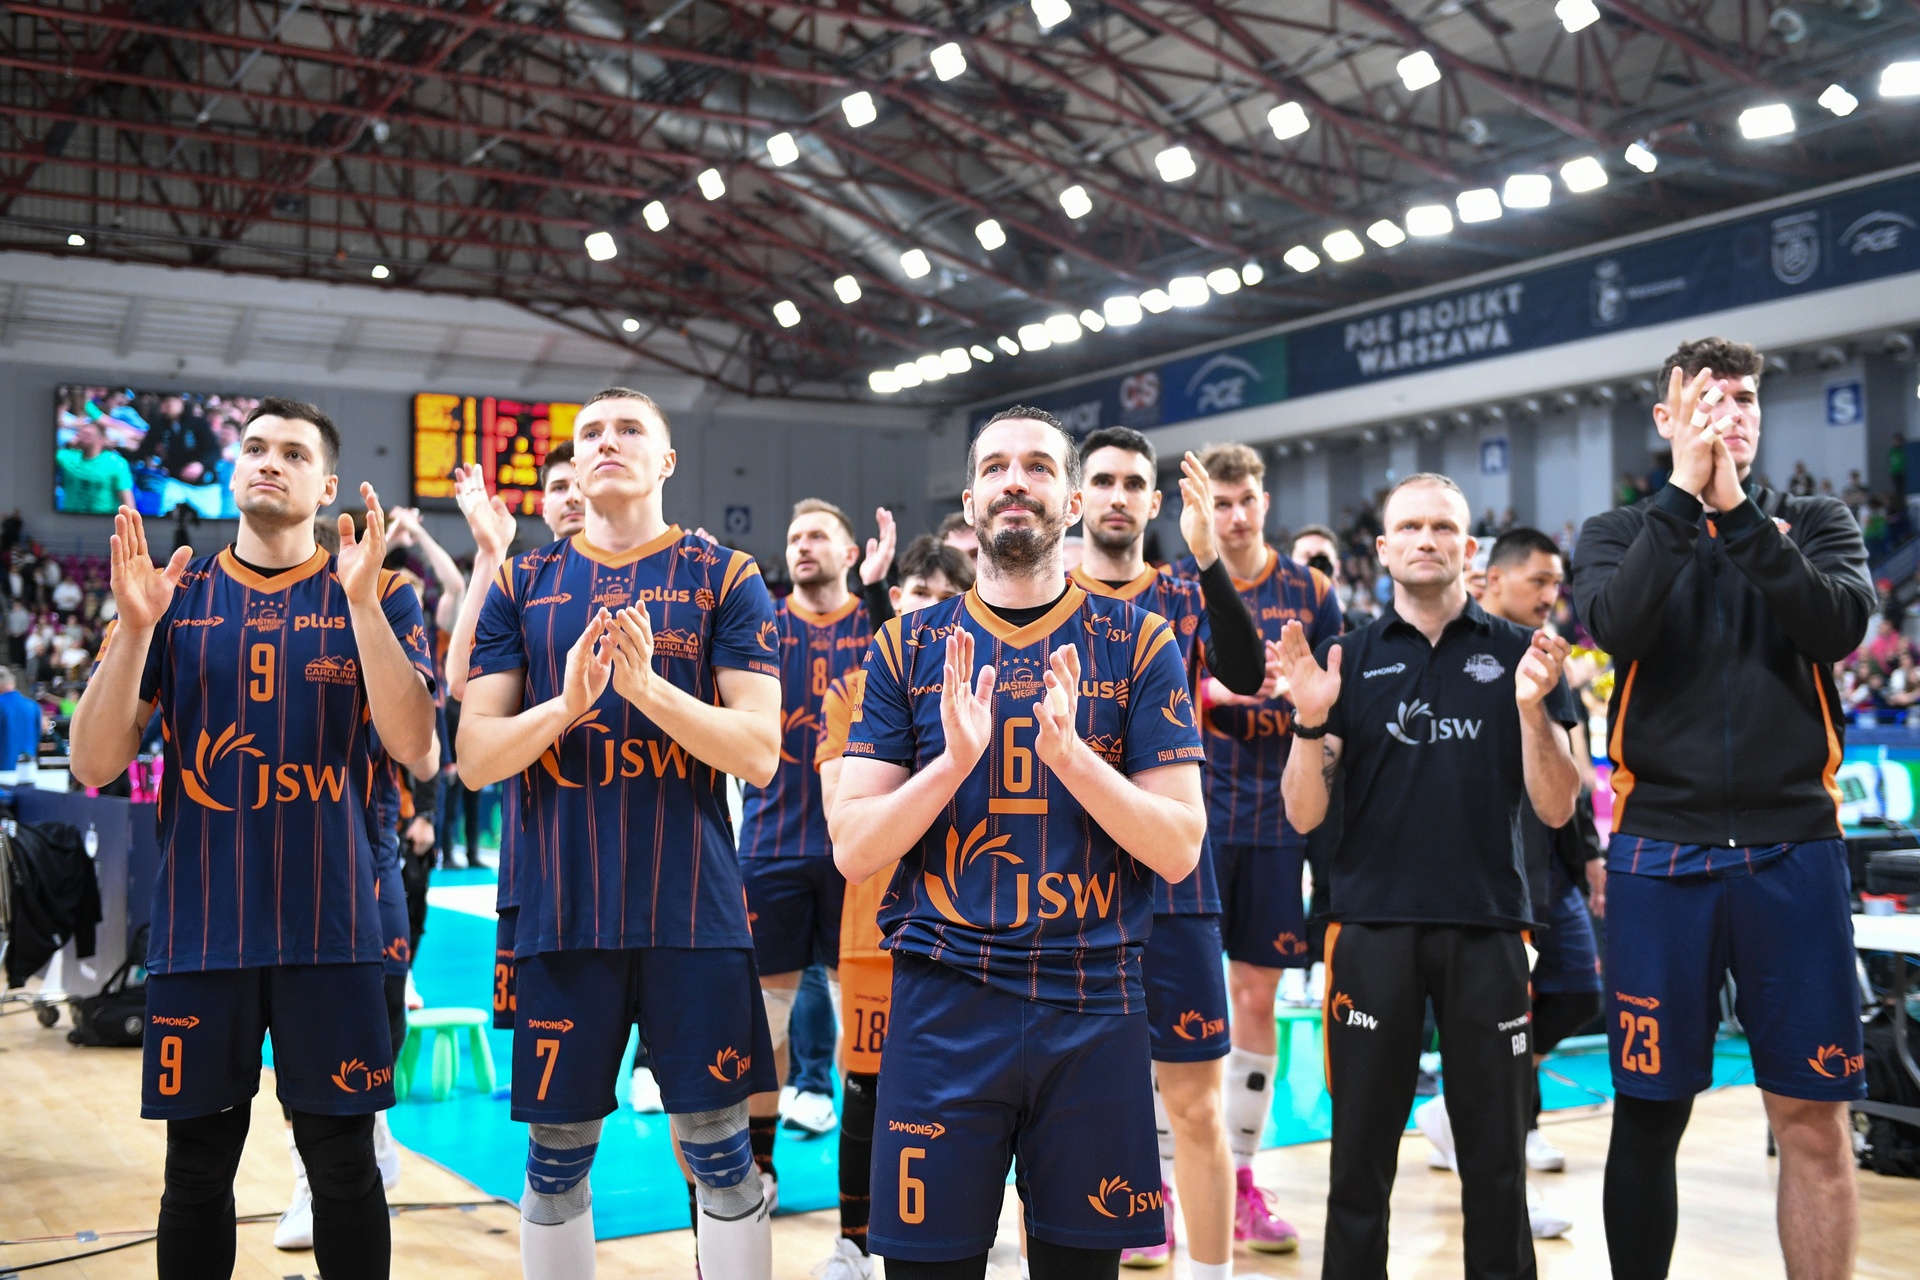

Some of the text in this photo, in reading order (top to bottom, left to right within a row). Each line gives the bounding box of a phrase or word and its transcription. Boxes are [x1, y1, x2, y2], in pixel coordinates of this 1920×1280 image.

[1400, 283, 1524, 336] PROJEKT
[1356, 319, 1512, 376] WARSZAWA
[1832, 387, 1857, 424] S
[639, 586, 690, 602] plus
[294, 613, 345, 631] plus
[654, 641, 698, 655] AROLINA
[251, 643, 275, 702] 9
[305, 668, 356, 680] CAROLINA
[305, 675, 330, 683] TOYOTA
[812, 656, 828, 697] 8
[911, 683, 943, 697] DAMO
[1078, 680, 1115, 699] us
[1427, 718, 1482, 744] JSW
[599, 738, 689, 787] JSW
[1003, 717, 1032, 793] 6
[252, 763, 346, 810] JSW
[1008, 872, 1116, 928] JSW
[152, 1015, 188, 1027] DAMONS
[529, 1019, 564, 1030] DAMONS
[852, 1008, 885, 1053] 18
[1201, 1018, 1225, 1039] JSW
[1346, 1009, 1379, 1030] JSW
[1619, 1010, 1661, 1075] 23
[159, 1036, 183, 1096] 9
[365, 1066, 391, 1091] JSW
[536, 1038, 560, 1100] 7
[889, 1120, 934, 1136] DAMONS
[898, 1147, 926, 1224] 6
[1127, 1190, 1163, 1217] JSW
